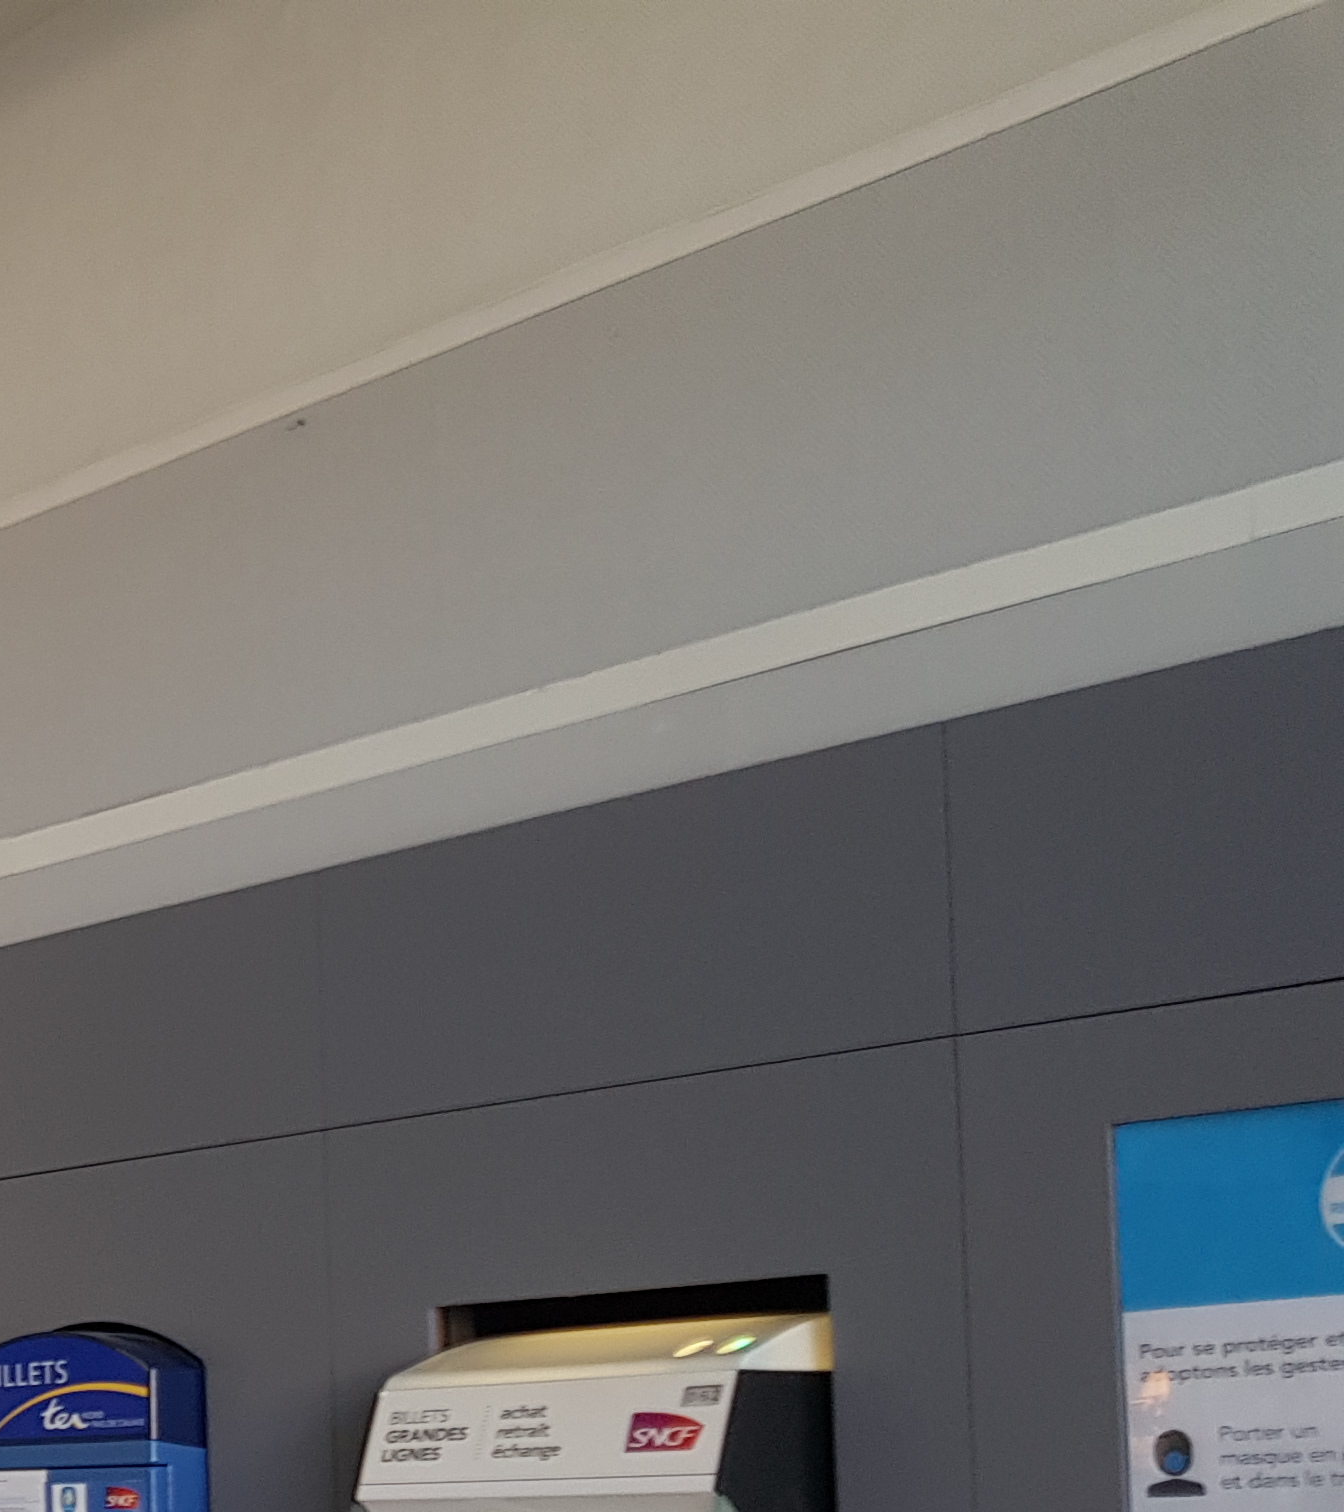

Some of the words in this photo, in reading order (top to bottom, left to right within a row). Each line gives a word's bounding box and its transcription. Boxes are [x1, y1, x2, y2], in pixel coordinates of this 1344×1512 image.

[1139, 1343, 1185, 1359] Pour
[1192, 1344, 1215, 1356] se
[1222, 1334, 1318, 1358] protéger
[1244, 1358, 1275, 1376] les
[40, 1398, 91, 1430] ter
[389, 1408, 451, 1425] BILLETS
[500, 1405, 548, 1420] achat
[385, 1427, 470, 1443] GRANDES
[495, 1423, 551, 1439] retrait
[628, 1426, 700, 1448] SNCF
[1219, 1425, 1285, 1441] Porter
[1291, 1426, 1318, 1439] un
[380, 1447, 443, 1463] LIGNES
[491, 1444, 562, 1461] échange
[1220, 1451, 1303, 1469] masque
[1220, 1476, 1243, 1489] et
[1249, 1471, 1301, 1489] dans
